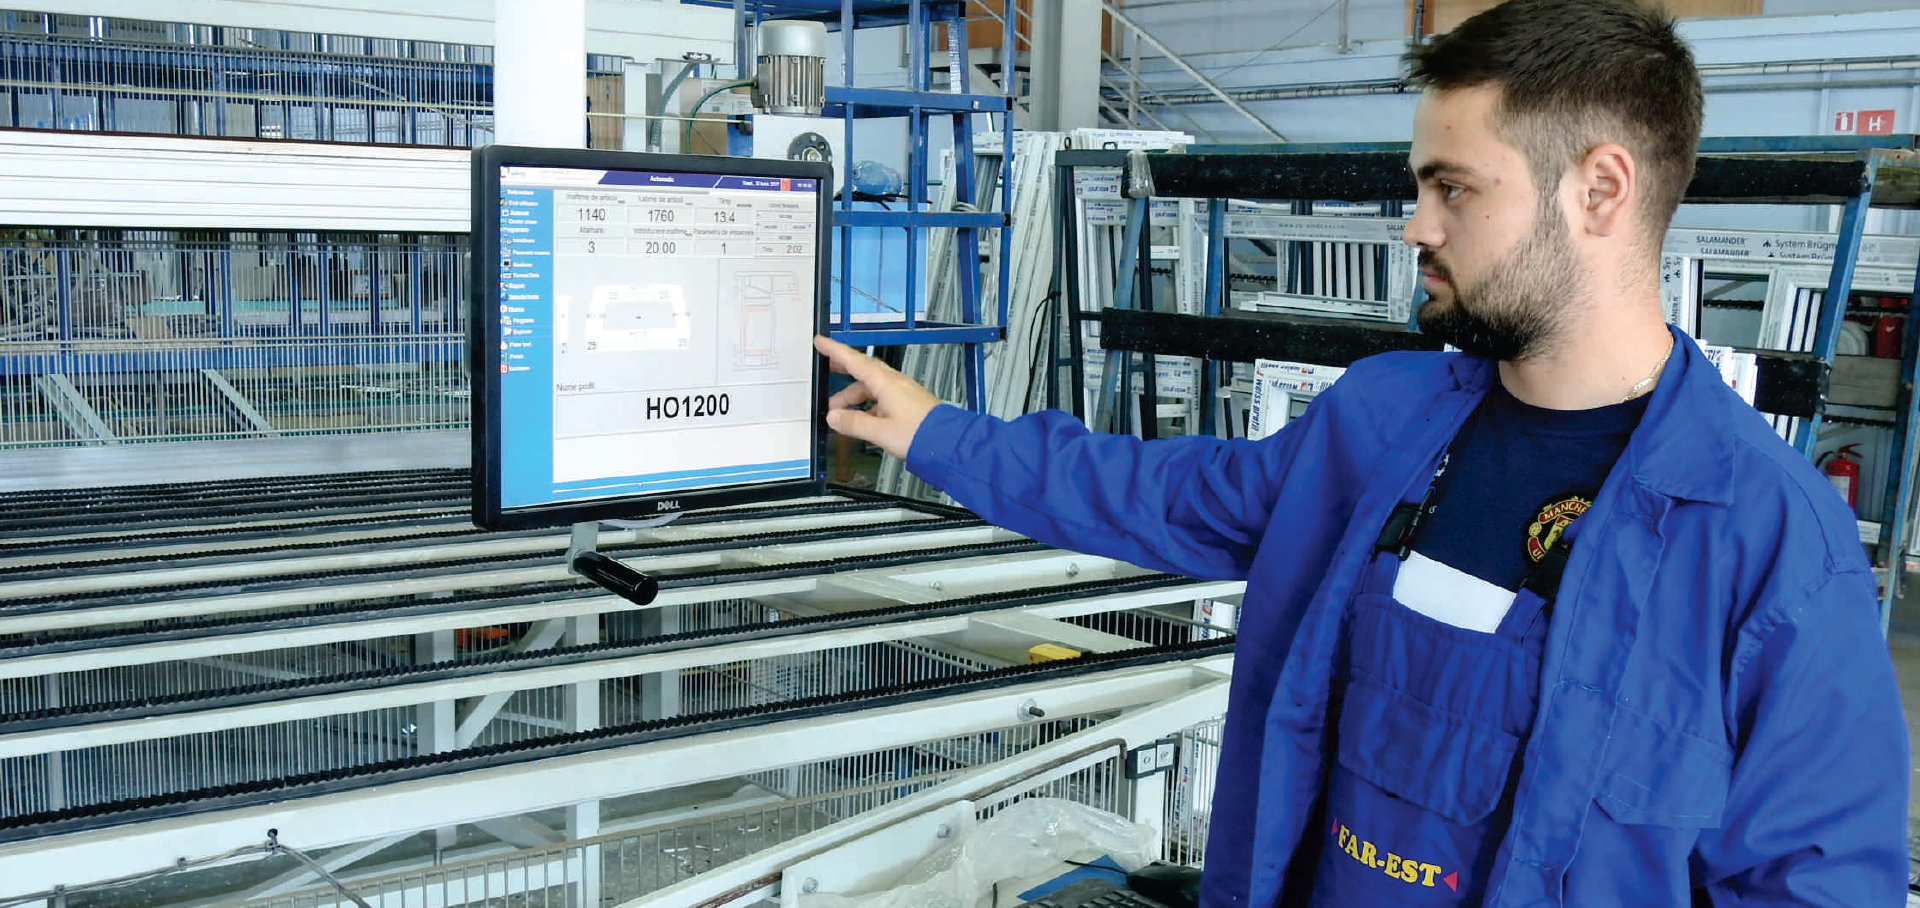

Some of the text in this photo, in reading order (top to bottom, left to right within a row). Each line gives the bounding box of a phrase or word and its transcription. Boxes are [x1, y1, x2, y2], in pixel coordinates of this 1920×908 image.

[578, 208, 606, 221] 1140
[648, 209, 675, 222] 1760
[588, 241, 596, 254] 3
[645, 241, 676, 254] 20.00
[721, 242, 727, 254] 1
[1775, 239, 1805, 250] System
[646, 393, 730, 420] HO1200
[657, 500, 680, 511] DELL
[1338, 824, 1442, 888] FAR-EST
